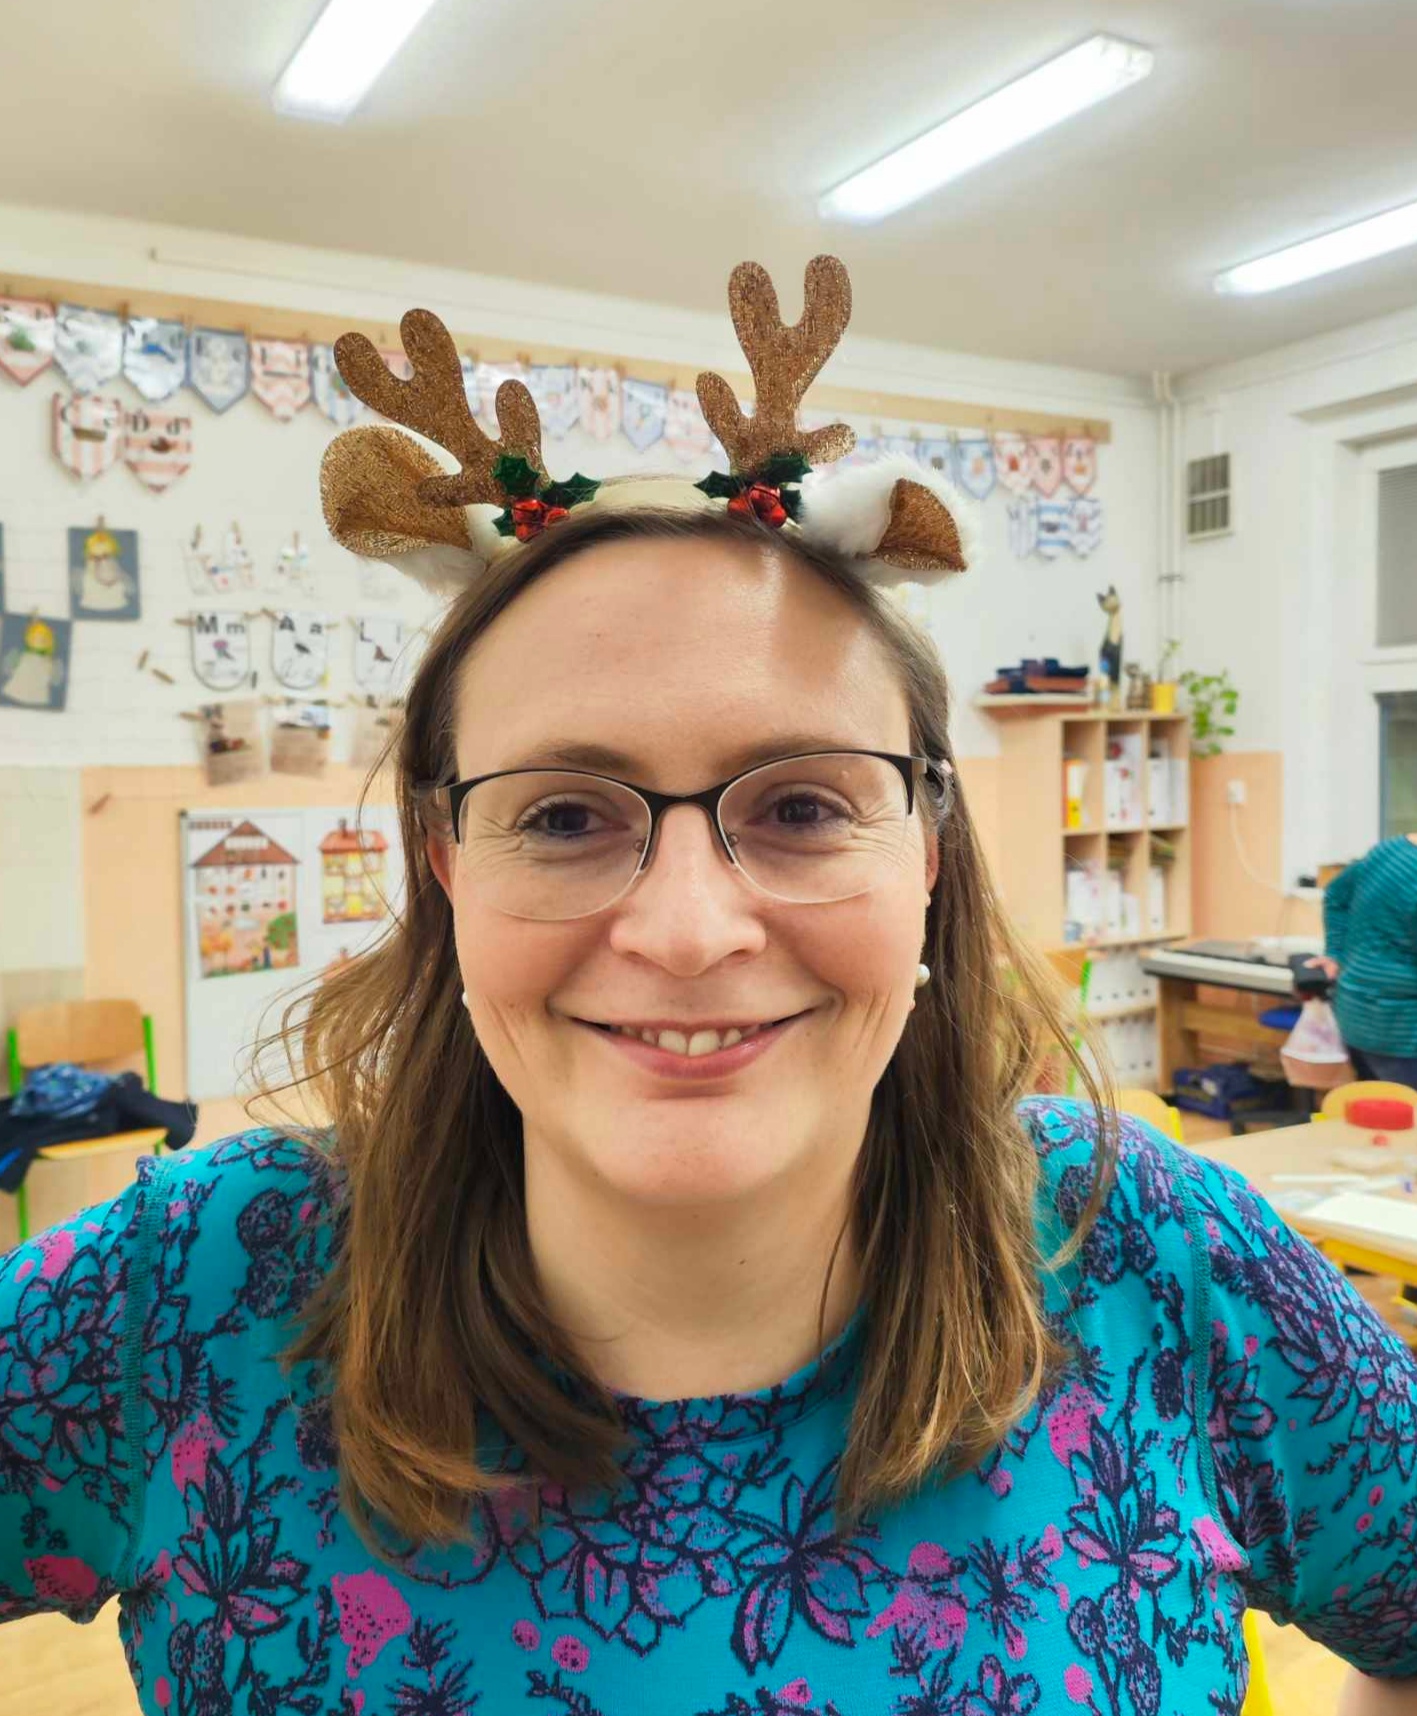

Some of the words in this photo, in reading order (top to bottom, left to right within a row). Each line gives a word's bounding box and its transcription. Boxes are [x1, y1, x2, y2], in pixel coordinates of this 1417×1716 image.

[196, 614, 219, 634] M
[225, 622, 247, 635] m
[278, 615, 295, 632] A
[310, 622, 323, 635] a
[360, 619, 373, 643] L
